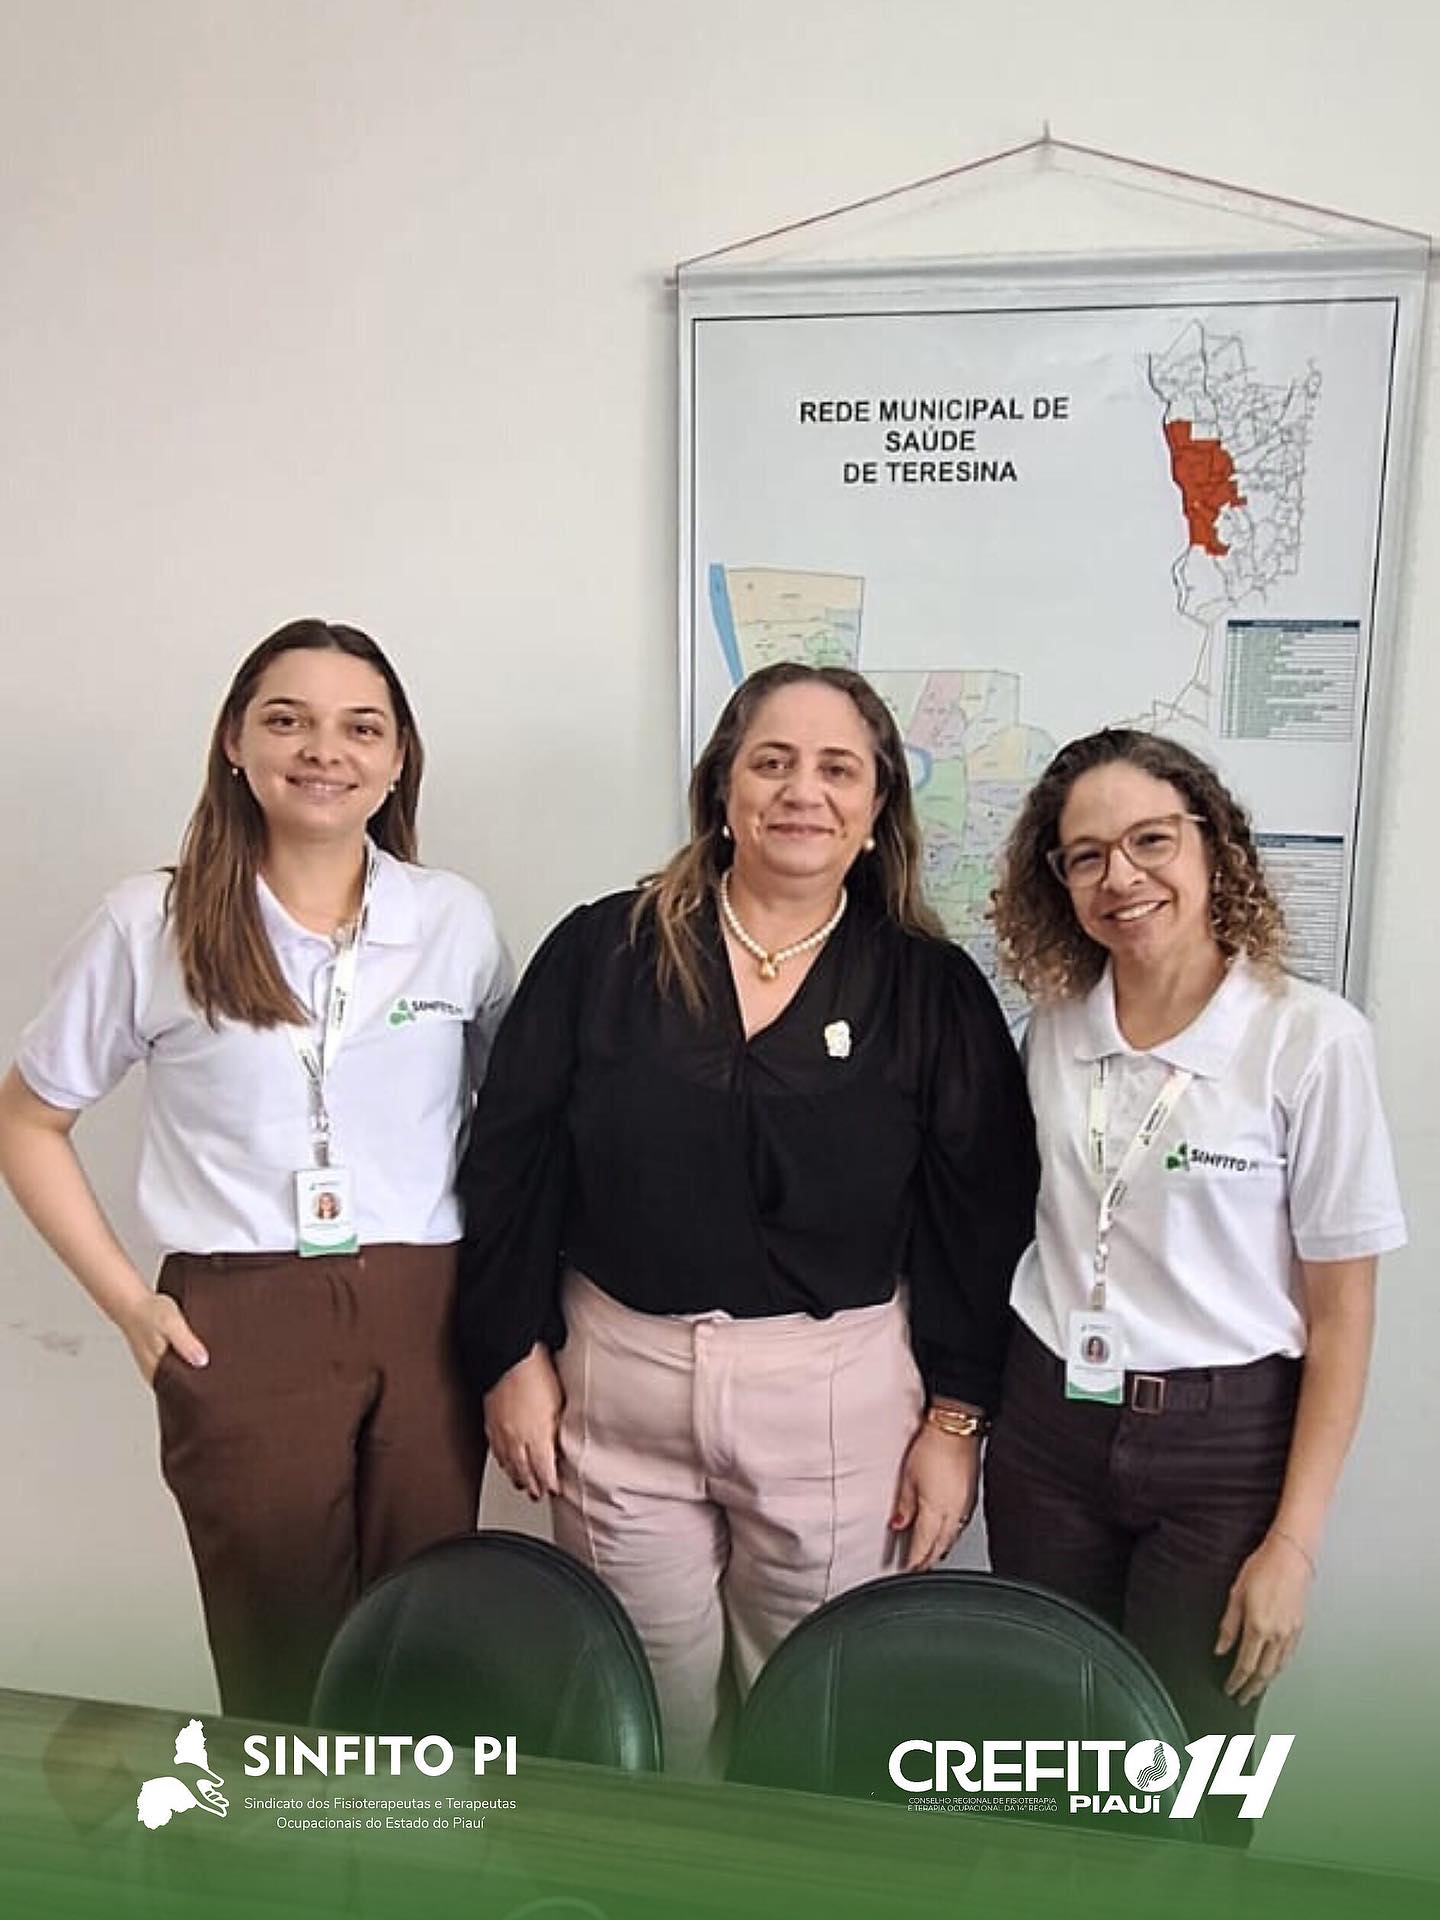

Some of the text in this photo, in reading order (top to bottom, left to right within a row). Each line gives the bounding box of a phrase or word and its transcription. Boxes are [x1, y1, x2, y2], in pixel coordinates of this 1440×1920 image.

[799, 397, 1070, 423] REDE MUNICIPAL DE
[885, 425, 976, 452] SAÚDE
[843, 461, 1018, 484] DE TERESINA
[1191, 1148, 1248, 1172] SINFITO
